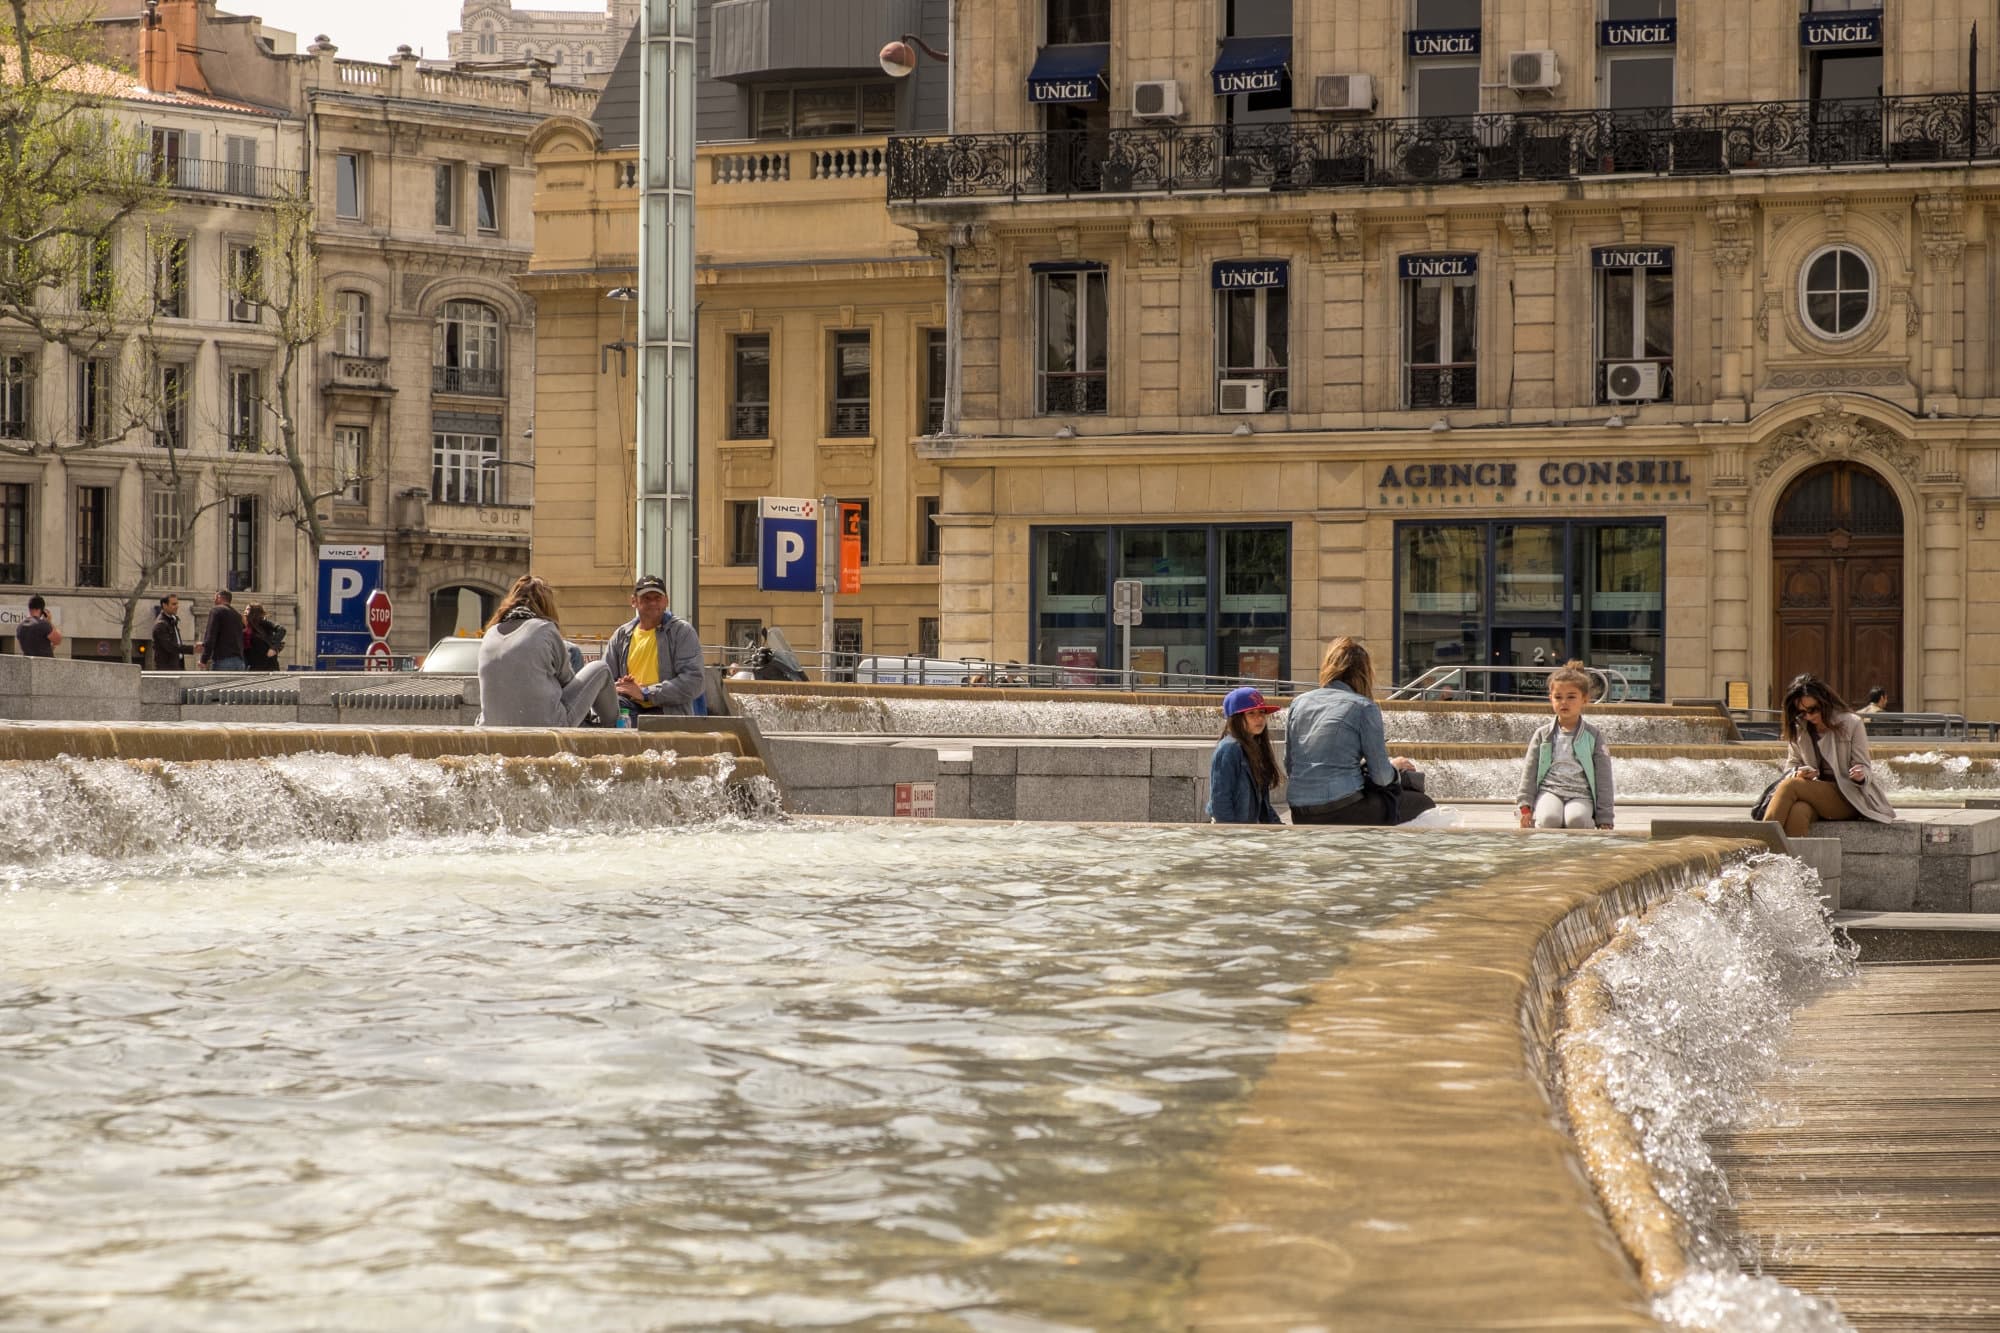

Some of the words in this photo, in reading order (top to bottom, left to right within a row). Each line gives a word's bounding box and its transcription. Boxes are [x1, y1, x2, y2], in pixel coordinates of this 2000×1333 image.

[1608, 27, 1670, 44] UNICIL
[1808, 26, 1872, 43] UNICIL
[1415, 38, 1474, 54] UNICIL
[1220, 73, 1278, 91] UNICIL
[1035, 84, 1091, 100] UNICIL
[1601, 251, 1663, 266] UNICIL
[1408, 261, 1467, 276] UNICIL
[1221, 271, 1278, 287] UNICIL
[1378, 463, 1517, 488] AGENCE
[1539, 460, 1691, 486] CONSEIL
[776, 531, 805, 577] P
[329, 568, 363, 614] P
[370, 608, 390, 622] STOP
[1533, 646, 1545, 662] 2
[1520, 679, 1545, 688] ACCU
